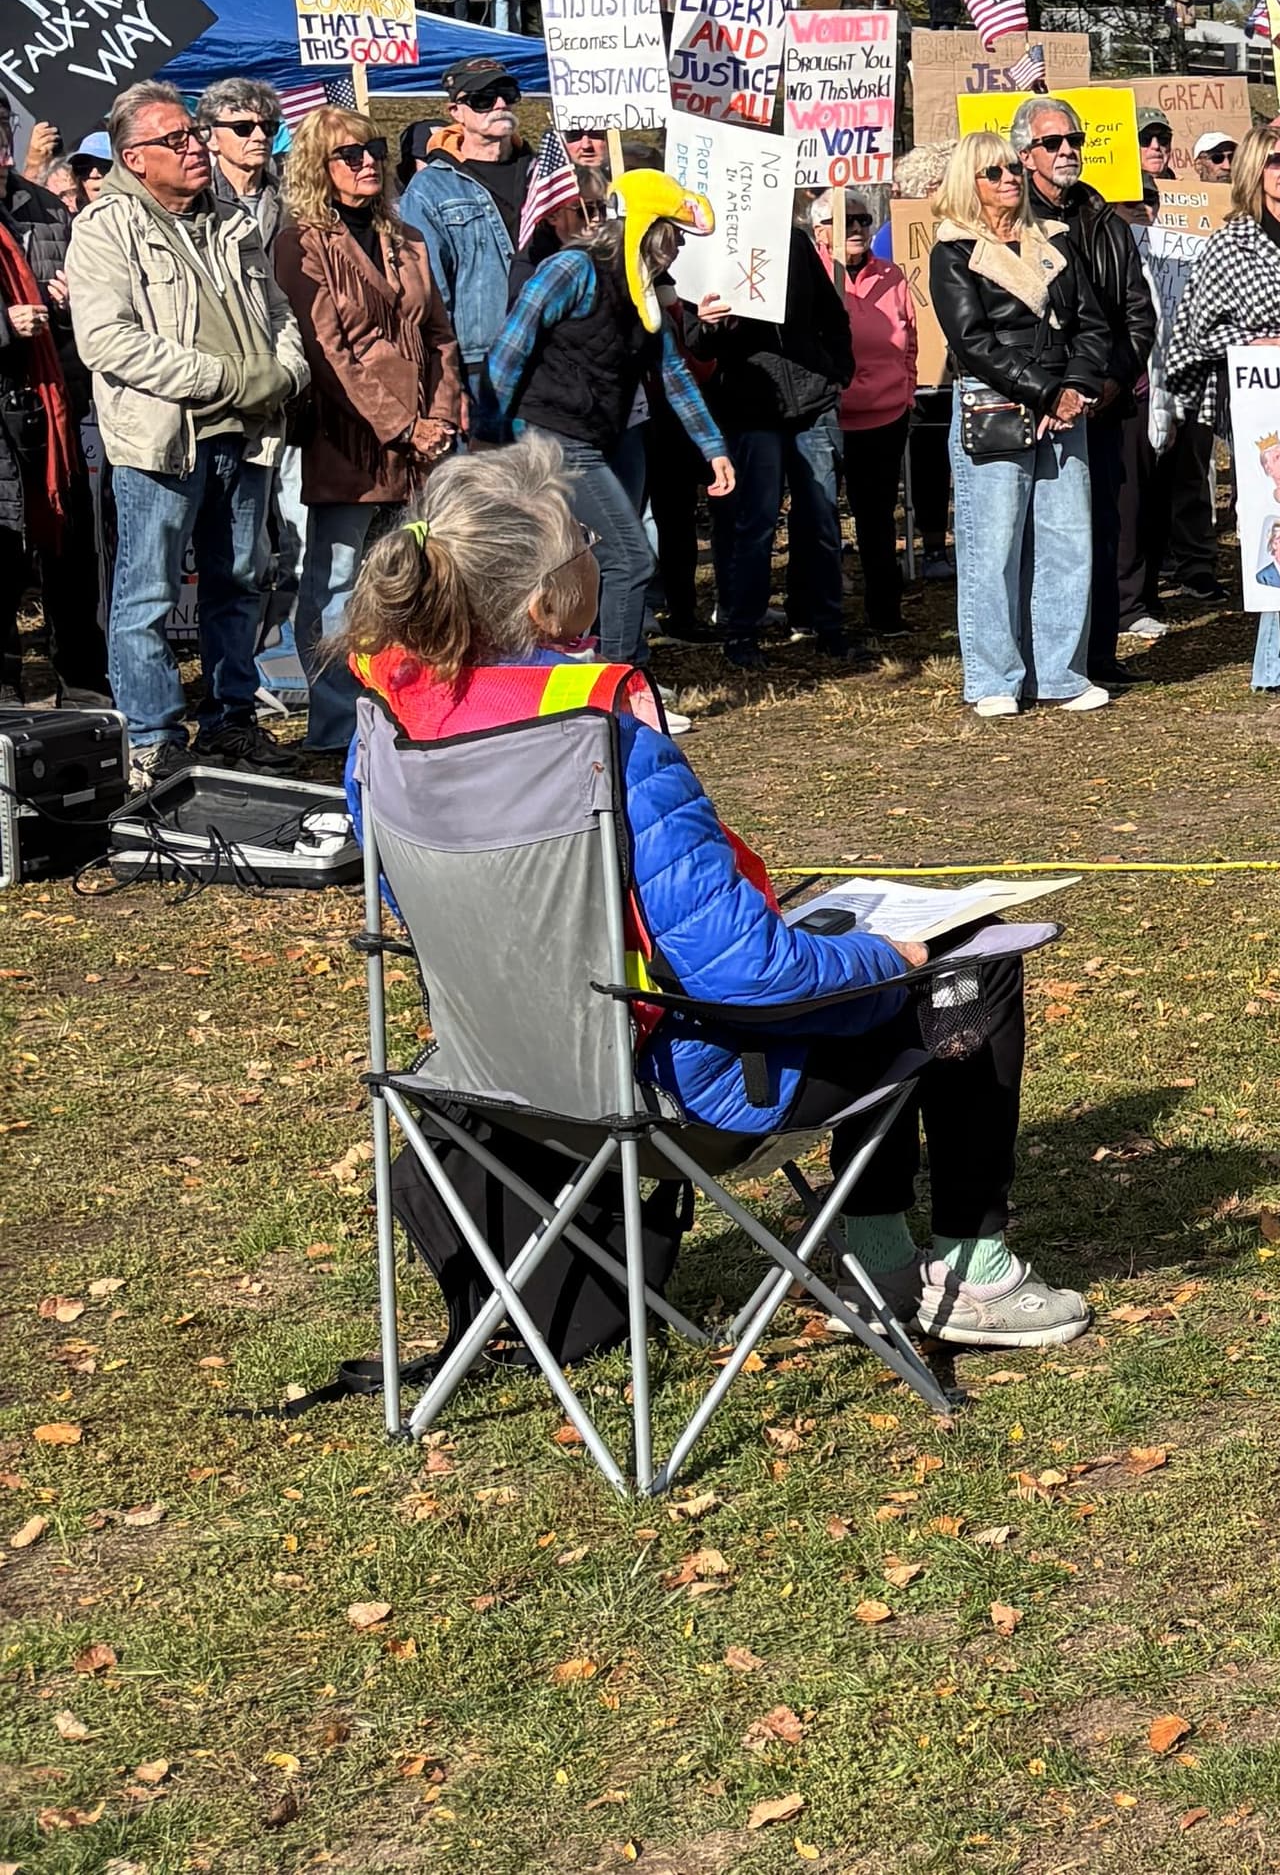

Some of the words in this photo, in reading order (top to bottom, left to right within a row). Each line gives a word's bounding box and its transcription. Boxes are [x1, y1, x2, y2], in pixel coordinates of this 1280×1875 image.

[68, 0, 172, 85] WAY
[300, 14, 361, 36] THAT
[367, 16, 412, 39] LET
[689, 20, 768, 59] AND
[789, 14, 889, 43] WOMEN
[302, 38, 348, 60] THIS
[550, 56, 668, 95] RESISTANCE
[671, 49, 780, 95] JUSTICE
[966, 63, 1017, 93] JES
[721, 93, 771, 123] ALL
[1159, 84, 1224, 111] GREAT
[787, 99, 892, 129] WOMEN
[798, 138, 817, 158] ill
[821, 126, 883, 156] VOTE
[696, 135, 712, 198] PROTE
[761, 151, 781, 188] NO
[795, 160, 820, 185] ou
[828, 153, 891, 187] OUT
[740, 161, 754, 211] KINGS
[1160, 191, 1208, 206] NGS!
[726, 191, 739, 255] AMERICA
[1163, 230, 1205, 256] FASC
